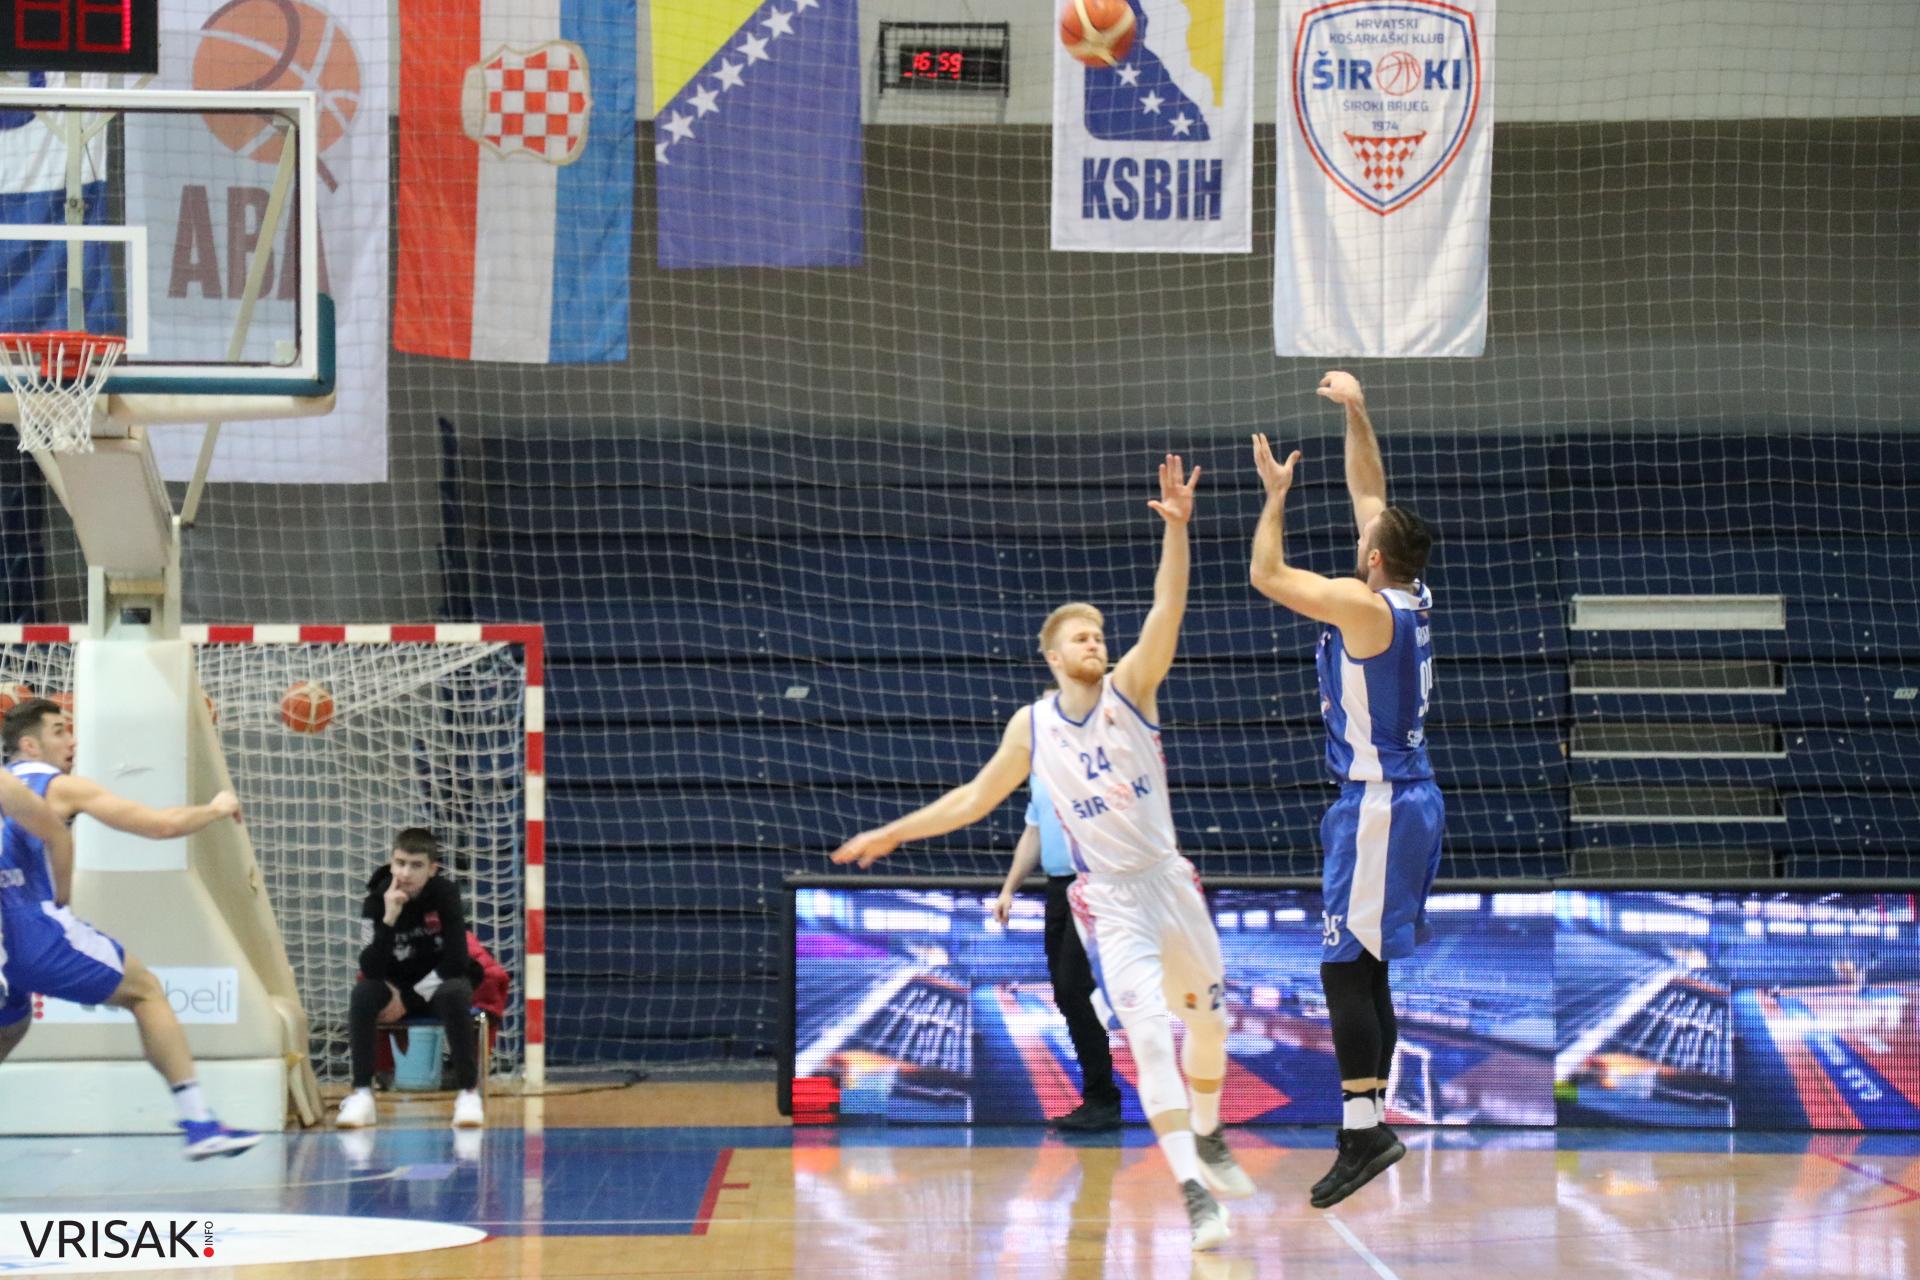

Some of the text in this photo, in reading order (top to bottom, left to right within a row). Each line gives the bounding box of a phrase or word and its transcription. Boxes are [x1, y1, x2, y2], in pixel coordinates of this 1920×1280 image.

[1355, 18, 1419, 30] HRVATSKI
[1411, 33, 1446, 45] KLUB
[1342, 99, 1430, 113] ŠIROKI BRIJEG
[1371, 120, 1400, 132] 1974
[1082, 157, 1223, 221] KSBIH
[1079, 745, 1112, 781] 24
